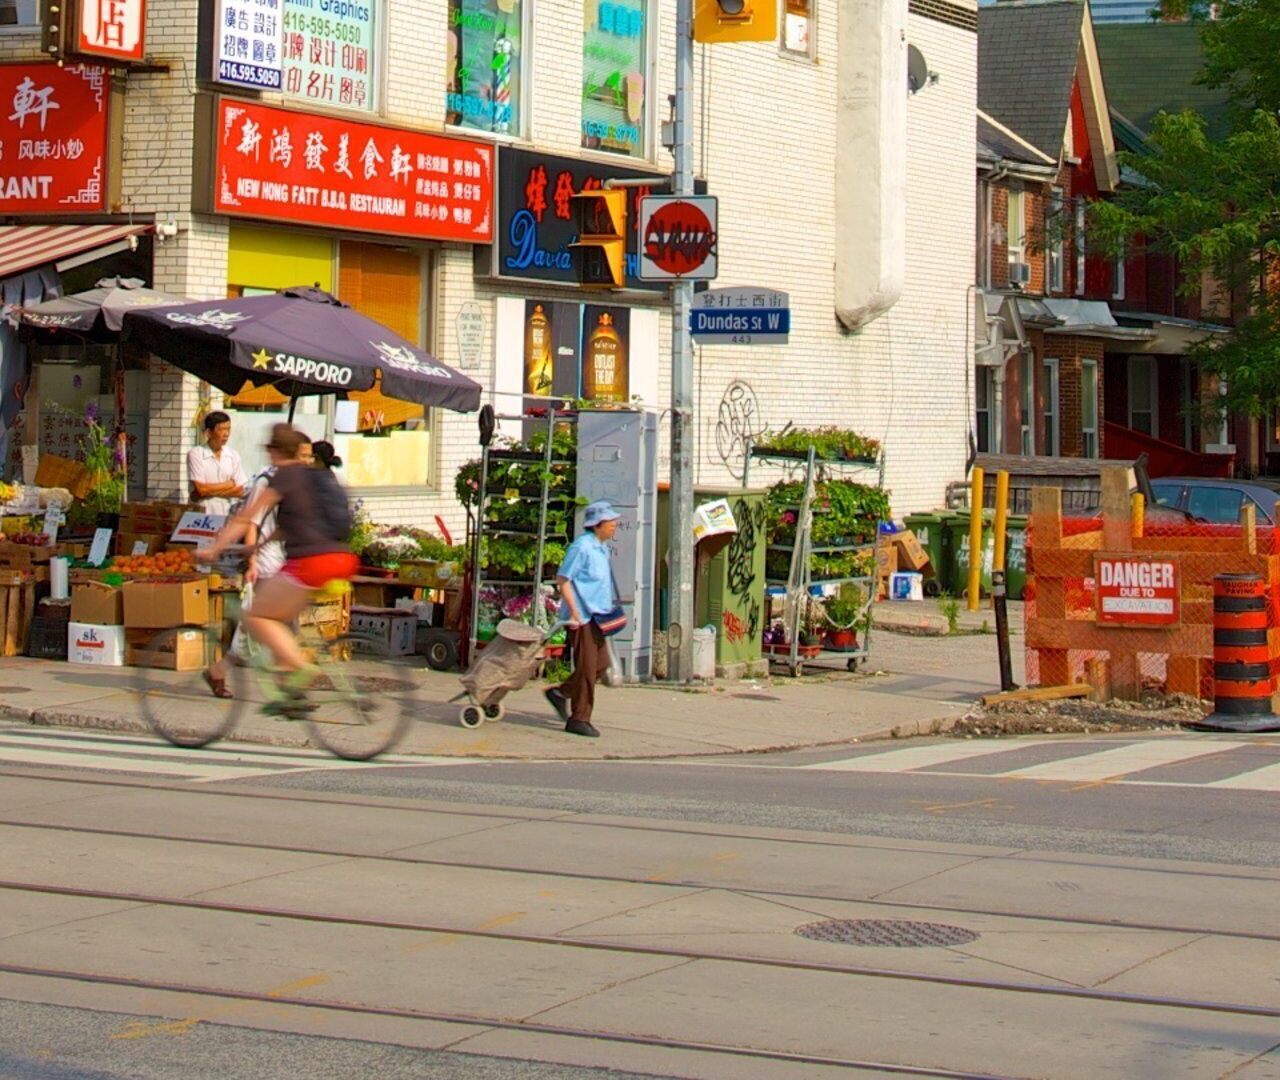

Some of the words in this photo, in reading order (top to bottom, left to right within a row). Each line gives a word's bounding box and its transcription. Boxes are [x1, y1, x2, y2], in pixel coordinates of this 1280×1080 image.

[220, 61, 279, 86] 416.595.5050
[18, 139, 84, 160] 风味小炒
[236, 117, 414, 187] 新鴻發美食軒
[237, 177, 261, 199] NEW
[262, 181, 288, 203] HONG
[292, 185, 320, 206] FATT
[698, 313, 748, 330] Dundas
[752, 317, 761, 330] St
[768, 313, 780, 330] W
[732, 335, 751, 343] 443
[274, 353, 353, 385] SAPPORO
[1100, 561, 1174, 588] DANGER
[1222, 581, 1258, 589] VAUGHAN
[1120, 588, 1139, 597] DUE
[1142, 588, 1155, 598] TO
[1104, 599, 1170, 612] EXCAVATION
